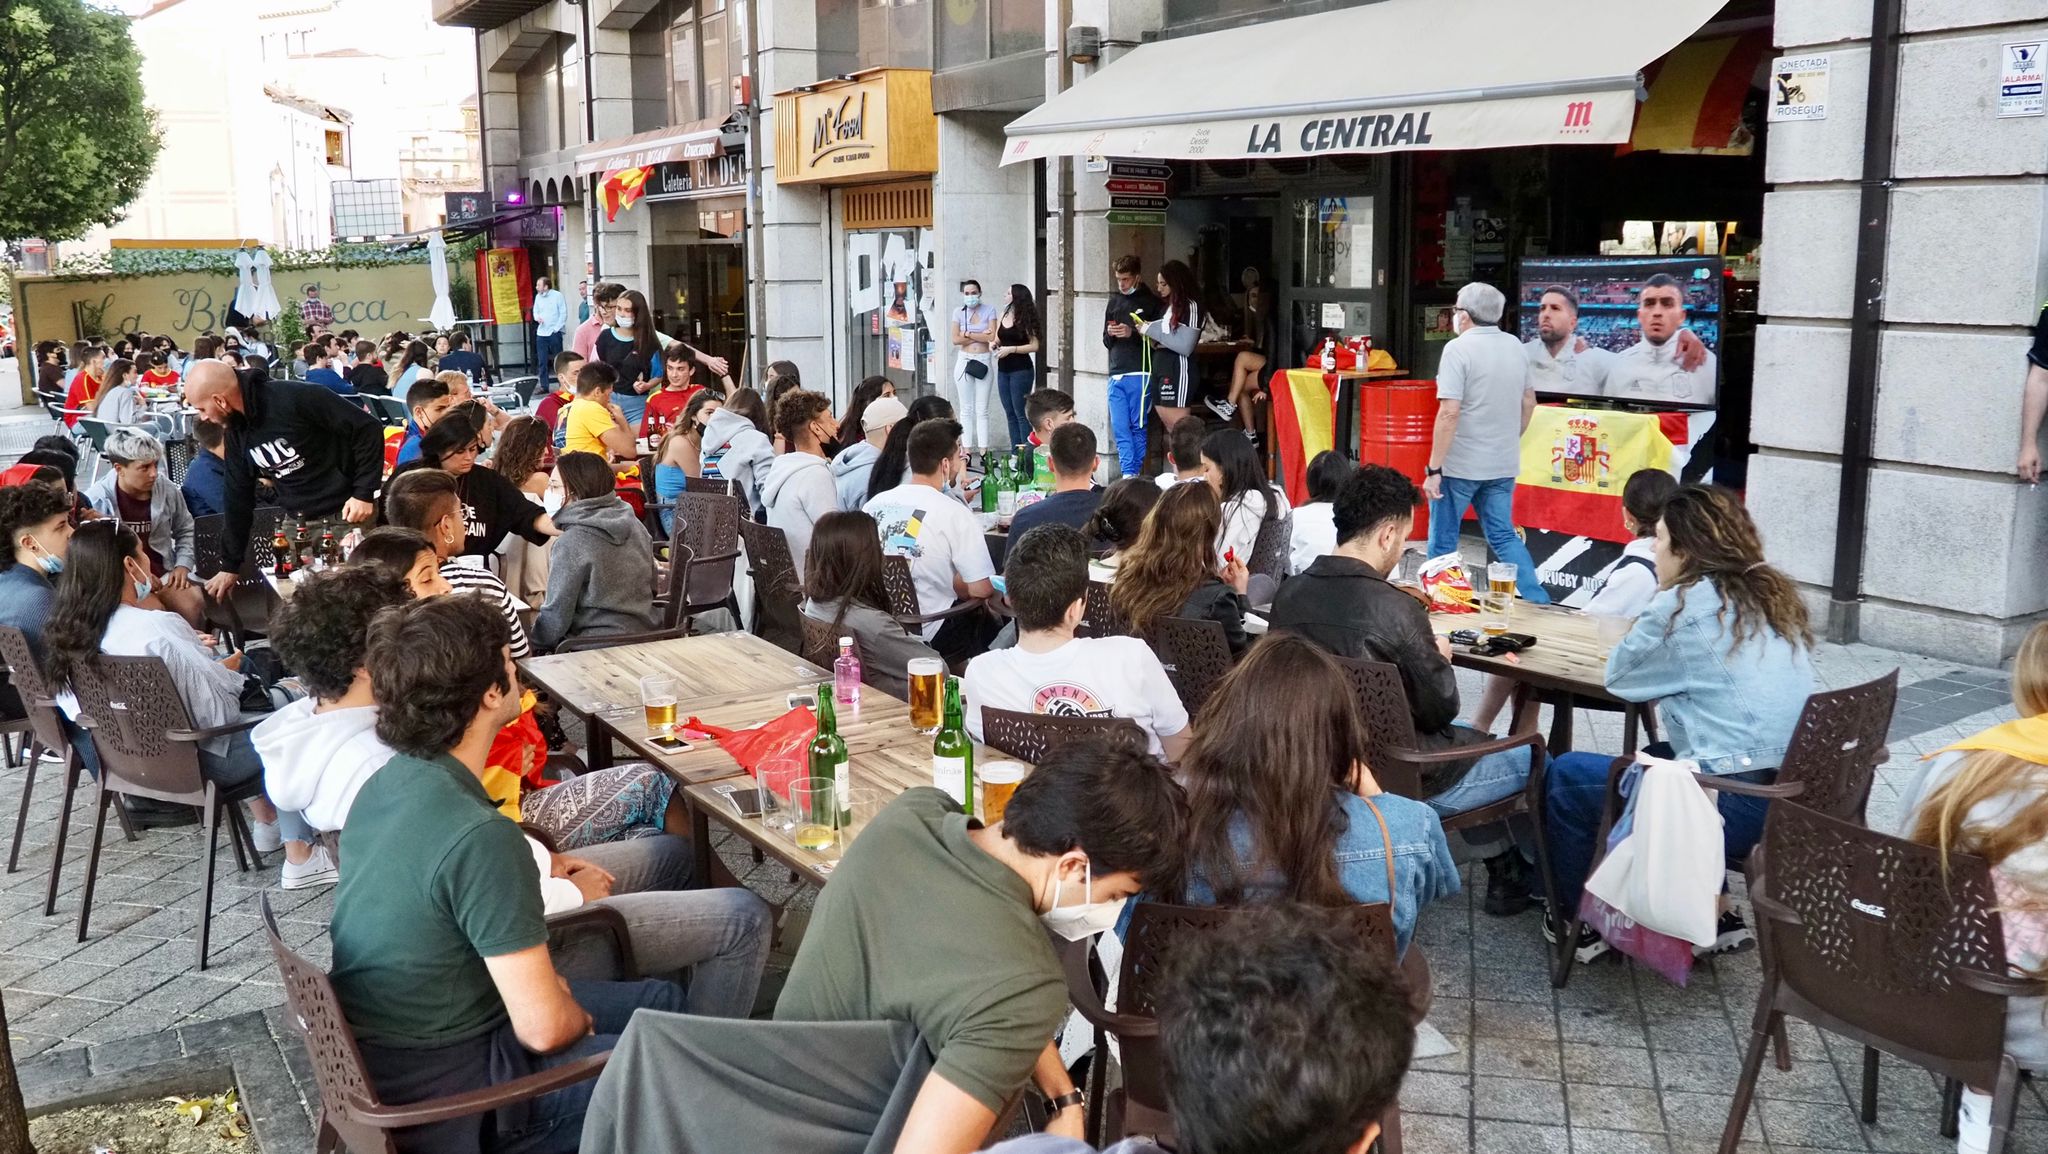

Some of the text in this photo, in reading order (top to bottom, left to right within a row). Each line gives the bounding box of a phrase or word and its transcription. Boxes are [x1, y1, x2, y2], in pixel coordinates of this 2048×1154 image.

[1777, 58, 1828, 69] ONECTADA
[1776, 104, 1825, 115] ROSEGUR
[1247, 112, 1433, 153] LA CENTRAL
[698, 158, 715, 188] EL
[719, 152, 747, 186] DEC
[249, 437, 296, 469] NYC
[1544, 569, 1578, 588] RUGBY
